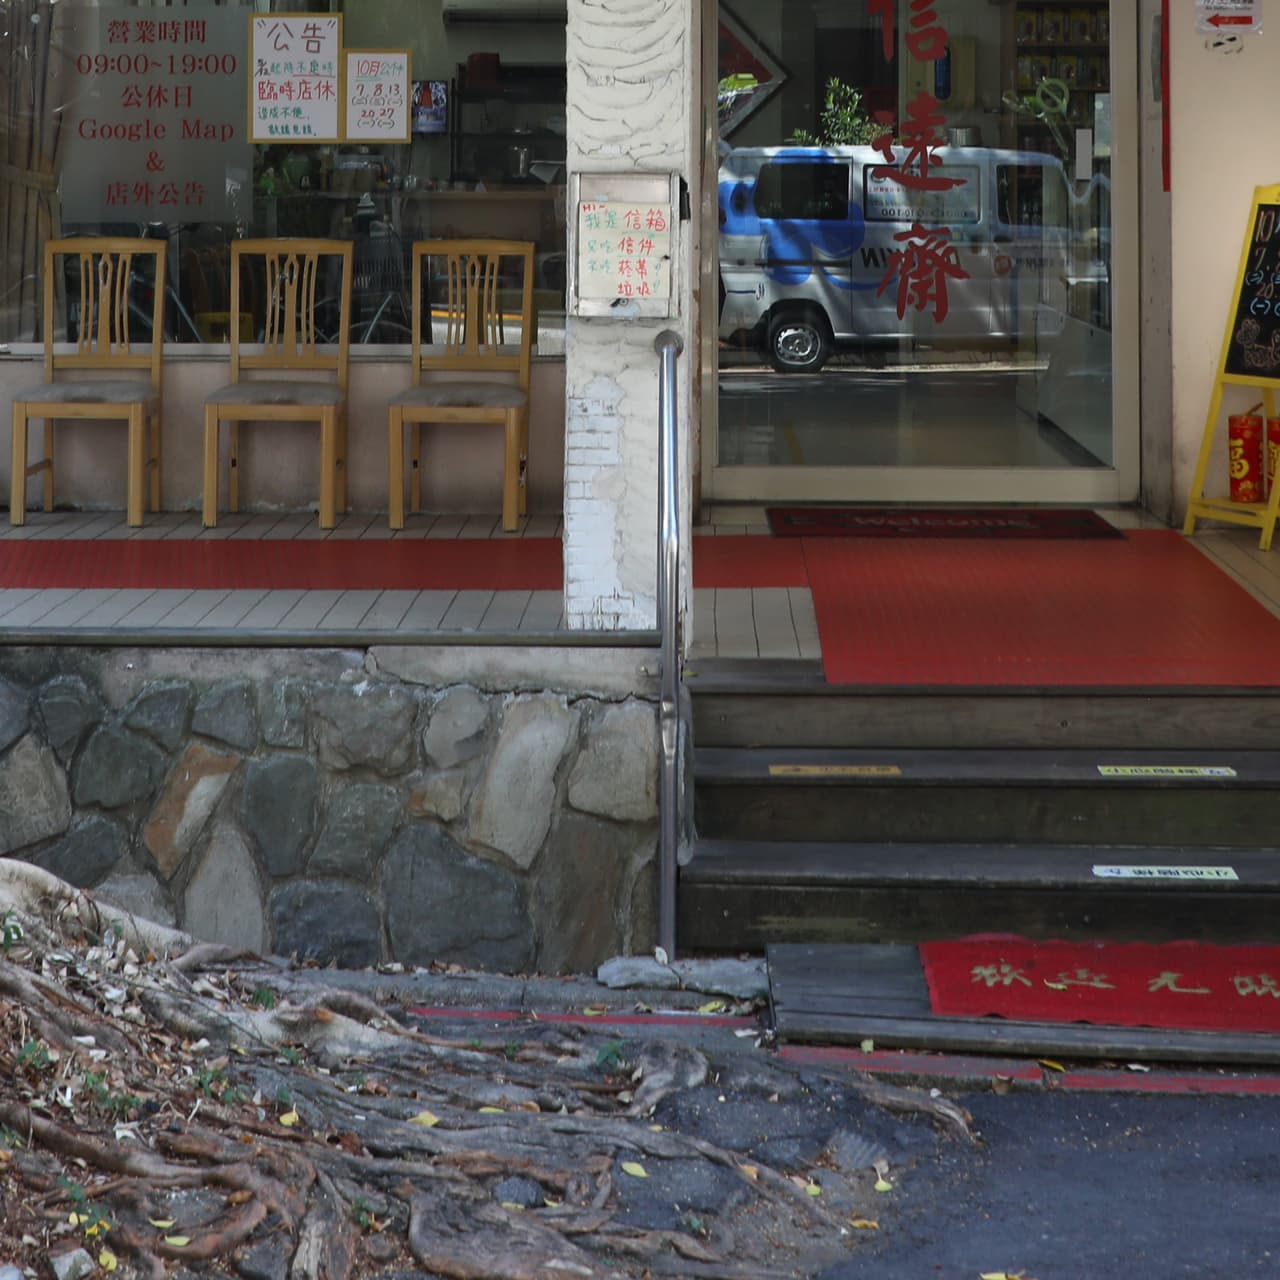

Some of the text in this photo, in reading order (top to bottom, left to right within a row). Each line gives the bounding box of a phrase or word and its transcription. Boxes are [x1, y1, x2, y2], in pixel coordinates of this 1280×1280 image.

[108, 20, 207, 44] 營業時間
[76, 54, 237, 75] 09:00~19:00
[122, 85, 192, 108] 公休日
[78, 118, 234, 142] Google Map
[146, 151, 165, 171] &
[105, 181, 205, 206] 店外公告
